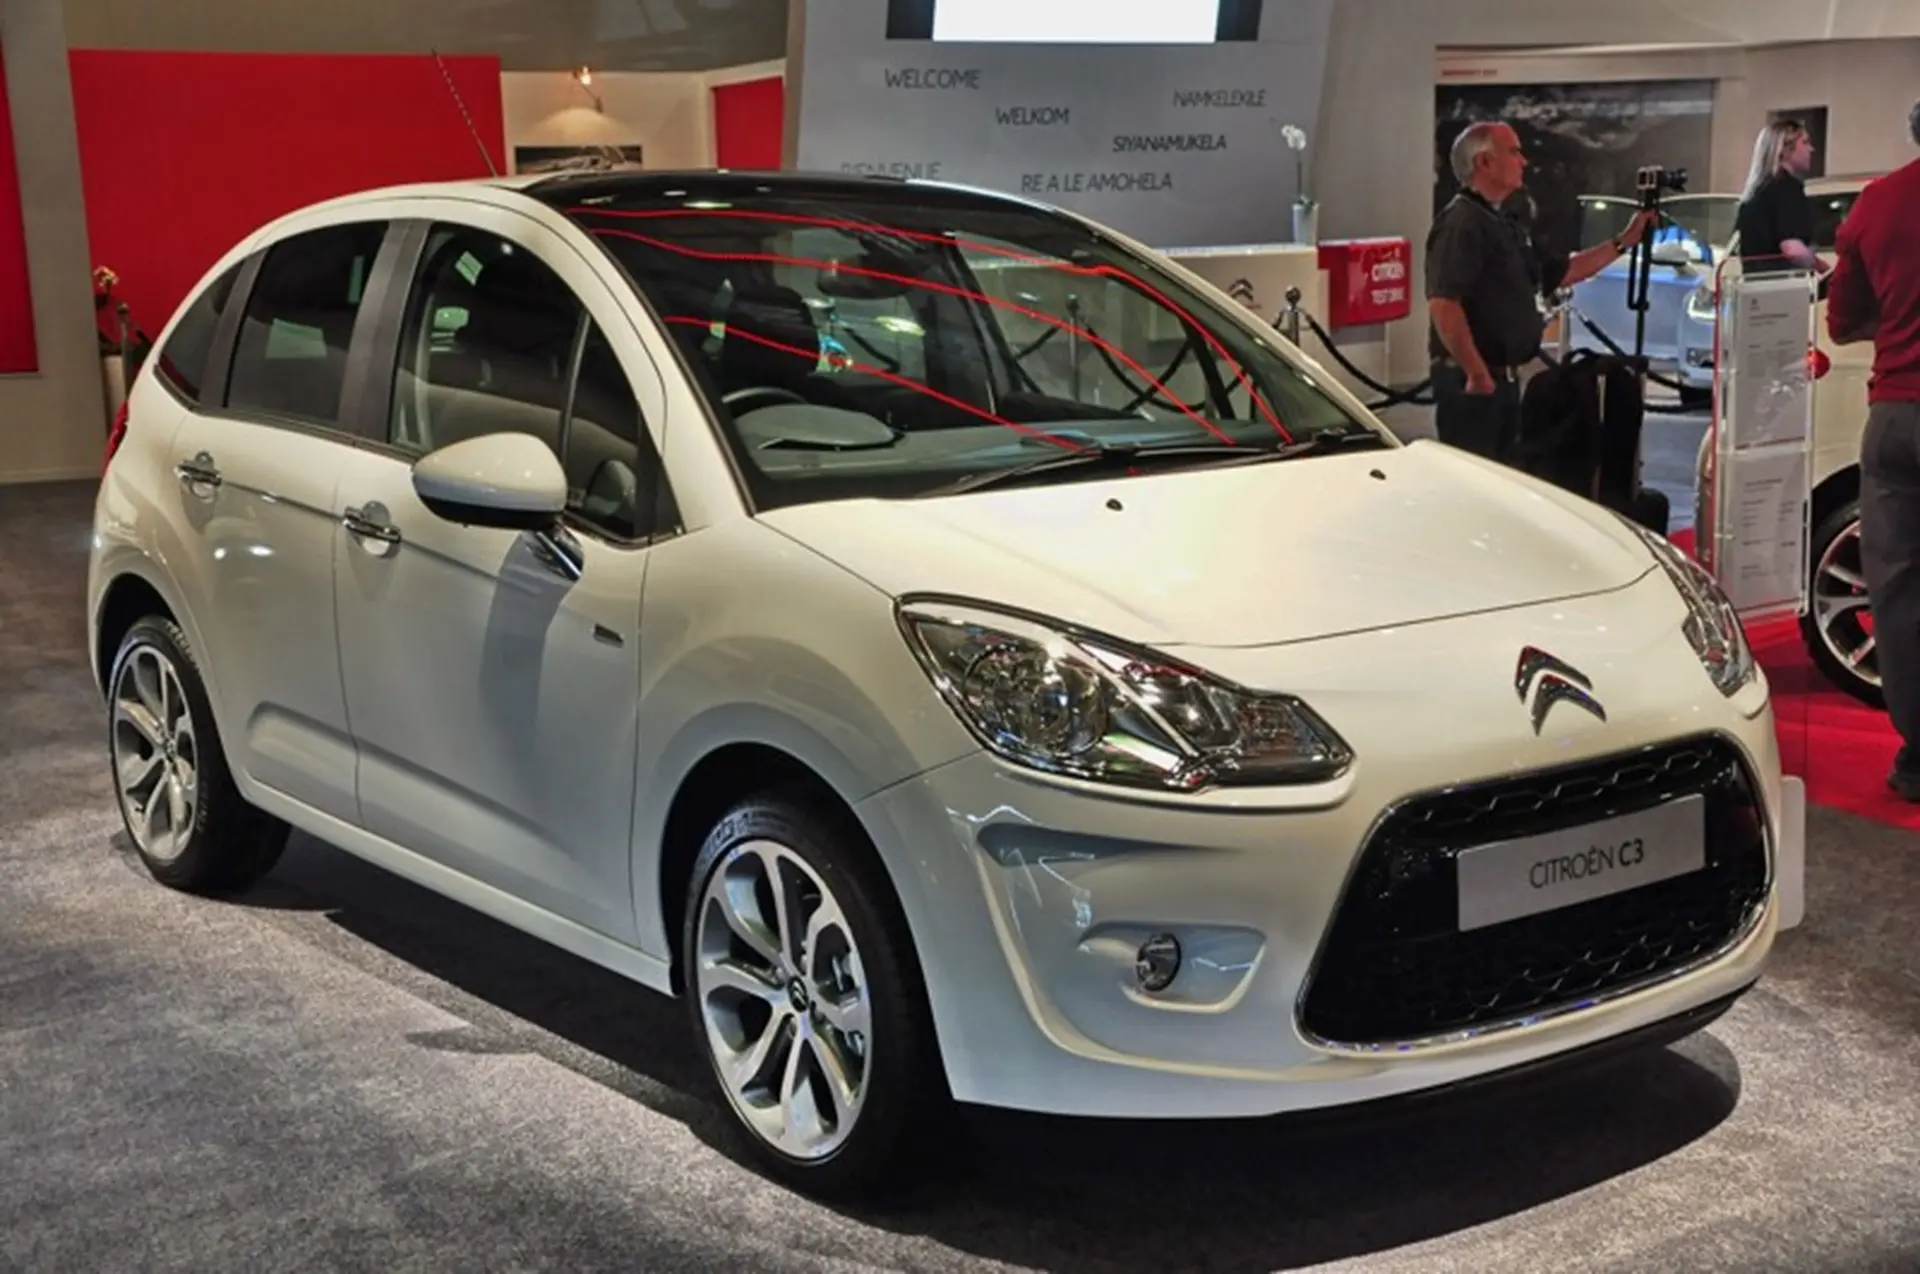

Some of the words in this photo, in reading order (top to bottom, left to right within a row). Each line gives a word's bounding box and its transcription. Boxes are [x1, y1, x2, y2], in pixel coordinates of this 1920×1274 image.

[884, 67, 981, 90] WELCOME
[995, 106, 1070, 126] WELKOM
[1112, 133, 1227, 152] SIYANAMUKELA
[1021, 173, 1044, 193] RE
[1046, 174, 1060, 193] A
[1063, 173, 1084, 193] LE
[1085, 172, 1173, 192] AMOHELA
[1618, 838, 1645, 868] C3
